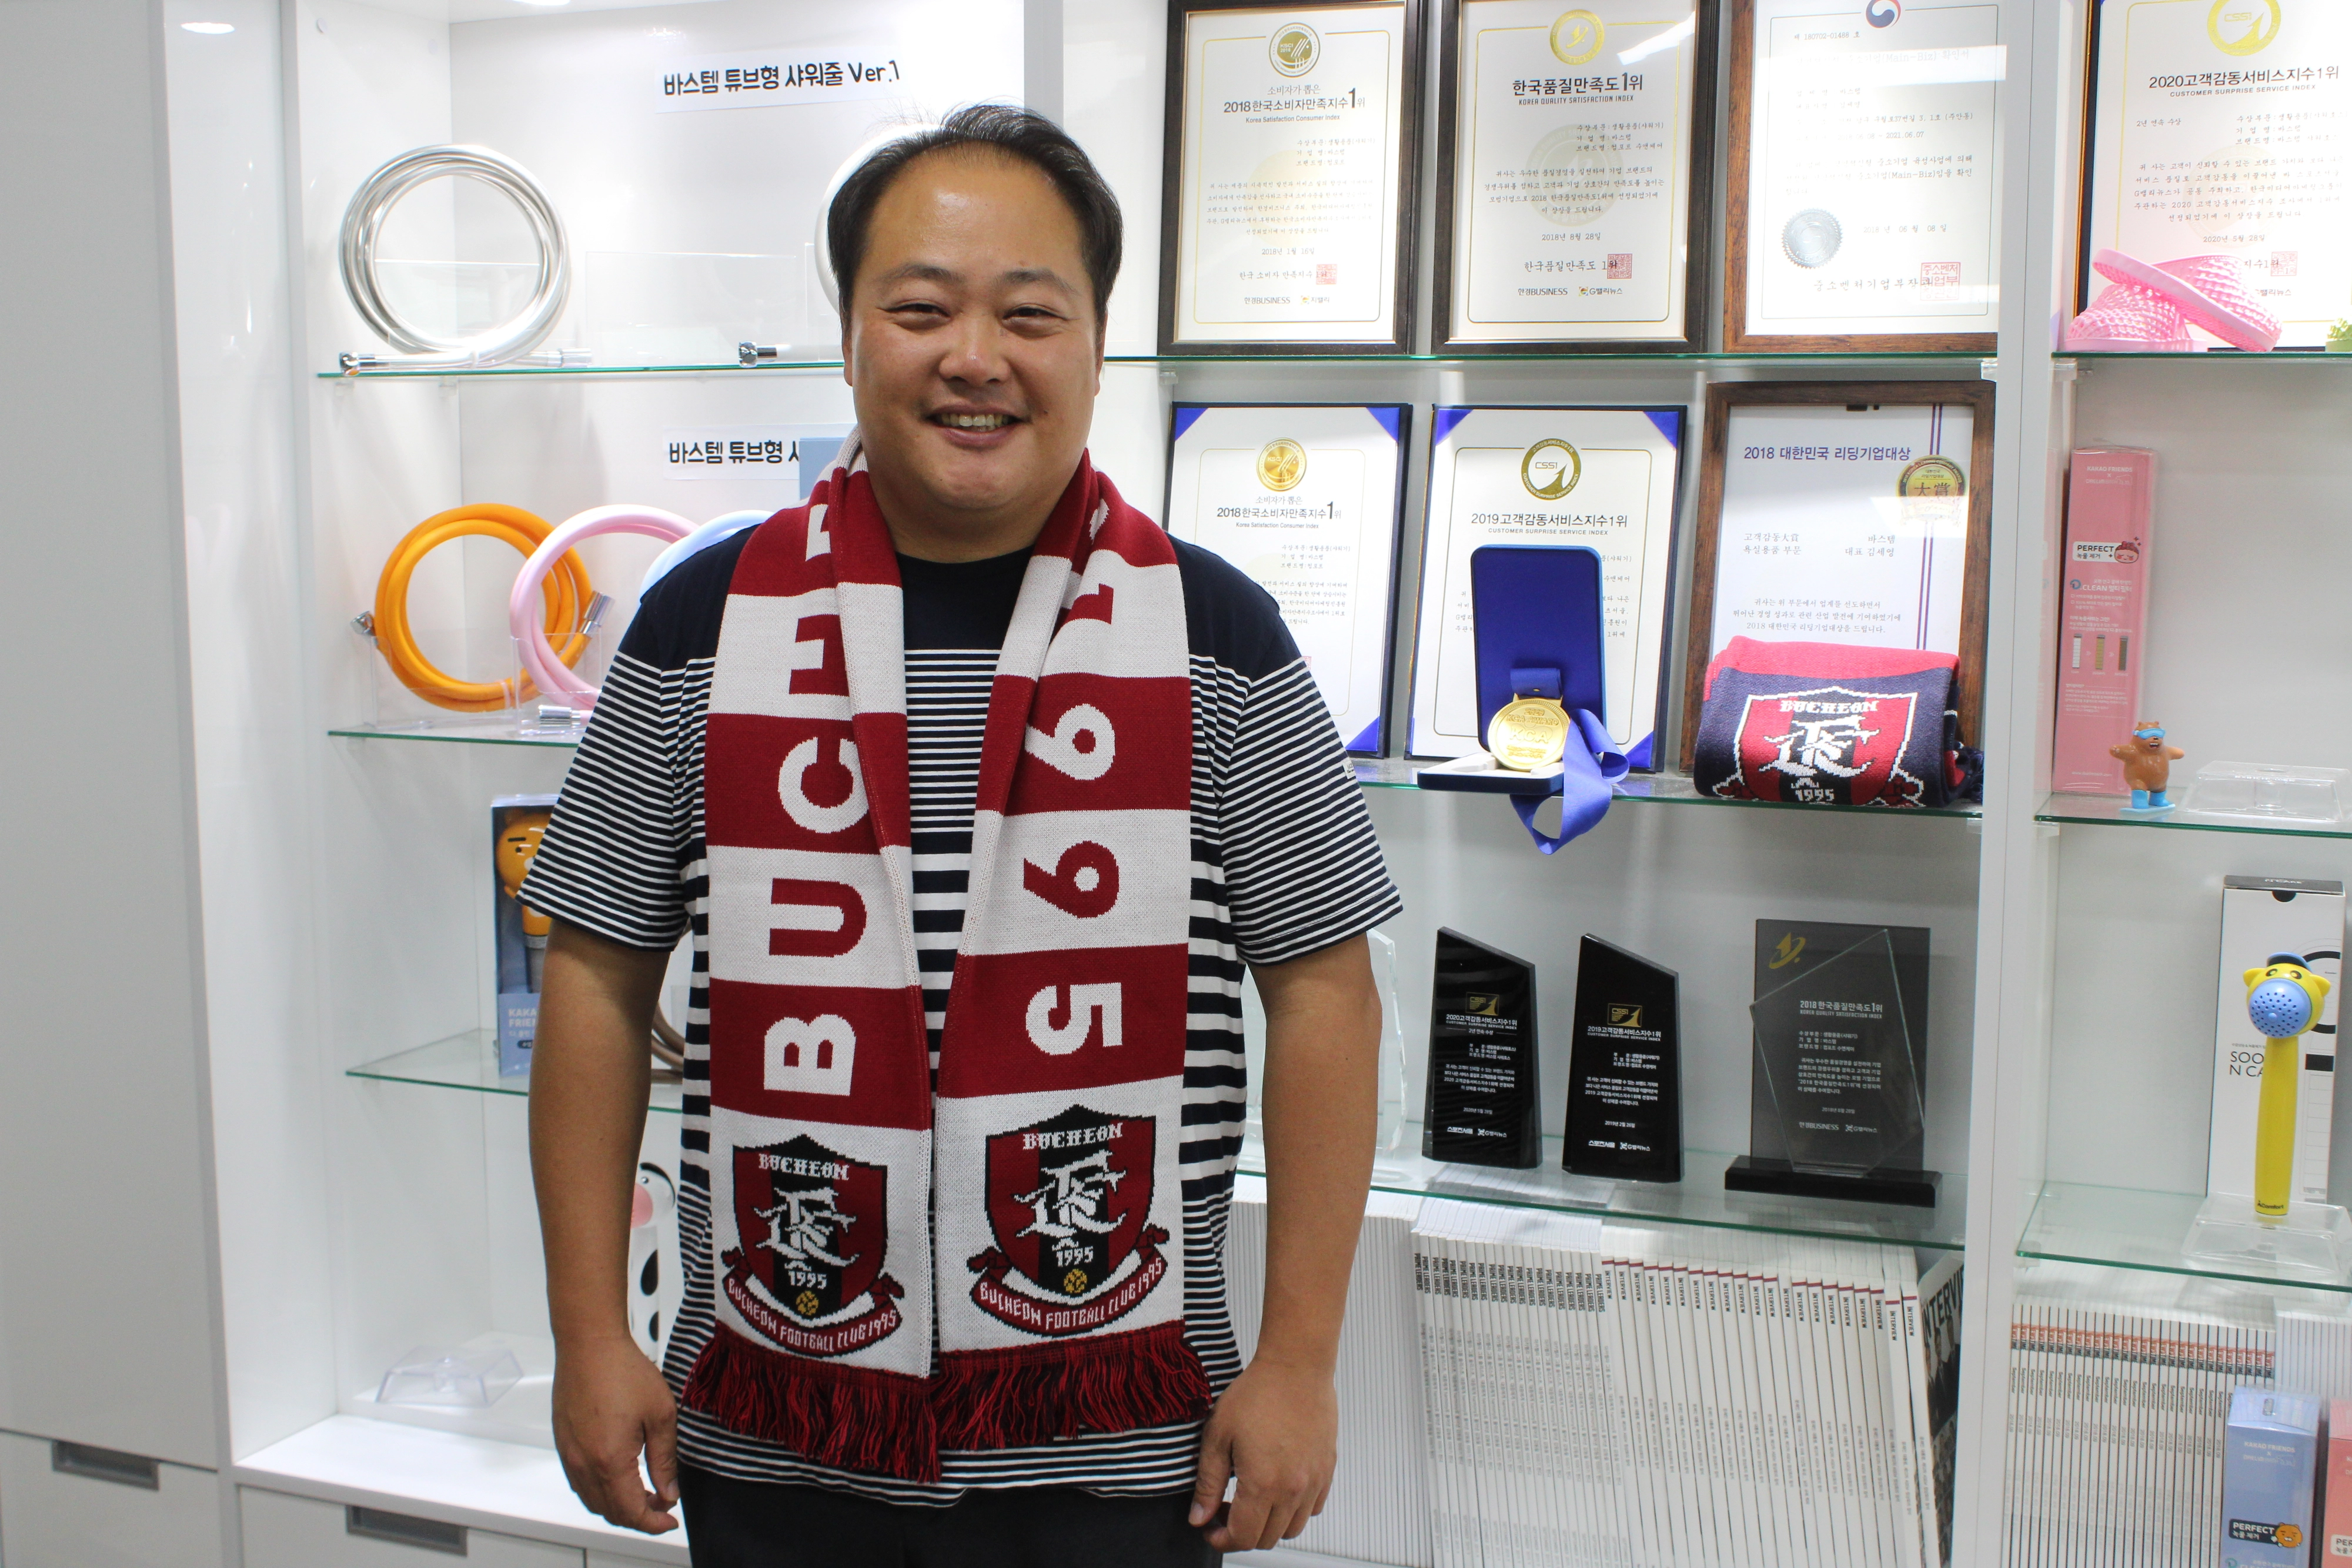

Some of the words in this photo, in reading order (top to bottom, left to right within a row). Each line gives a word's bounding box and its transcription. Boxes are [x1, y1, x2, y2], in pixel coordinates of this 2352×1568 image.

[1805, 32, 1849, 40] 180702-01488
[664, 71, 719, 95] 바스템
[724, 65, 779, 92] 튜브형
[785, 62, 843, 88] 샤워줄
[848, 61, 900, 83] Ver.1
[2149, 65, 2339, 89] 2020고객감동서비스지수1위
[1512, 72, 1643, 96] 한국품질만족도1위
[1268, 85, 1301, 96] 소비자가
[2170, 89, 2213, 98] CUSTOMER
[2215, 87, 2253, 95] SURPRISE
[2257, 86, 2290, 94] SERVICE
[2151, 119, 2164, 127] 연속
[669, 442, 723, 464] 바스템
[729, 440, 783, 464] 튜브형
[1744, 447, 1774, 459] 2018
[1780, 446, 1829, 460] 대한민국
[1835, 447, 1910, 460] 리딩기업대상
[1255, 496, 1286, 505] 소비자가
[1471, 512, 1627, 527] 2019고객감동서비스지수1위
[1868, 535, 1895, 544] 바스템
[1783, 545, 1802, 555] 부문
[1845, 548, 1863, 556] 대표
[1768, 623, 1797, 631] 대한민국
[1779, 700, 1879, 714] BUCHEON
[1795, 789, 1835, 801] 1995
[2230, 1064, 2241, 1075] N
[1023, 1122, 1123, 1151] BUCHEON
[758, 1154, 850, 1181] BUCHEON
[1056, 1246, 1093, 1268] 1995
[788, 1271, 827, 1289] 1995
[2233, 1522, 2275, 1534] PERFECT
